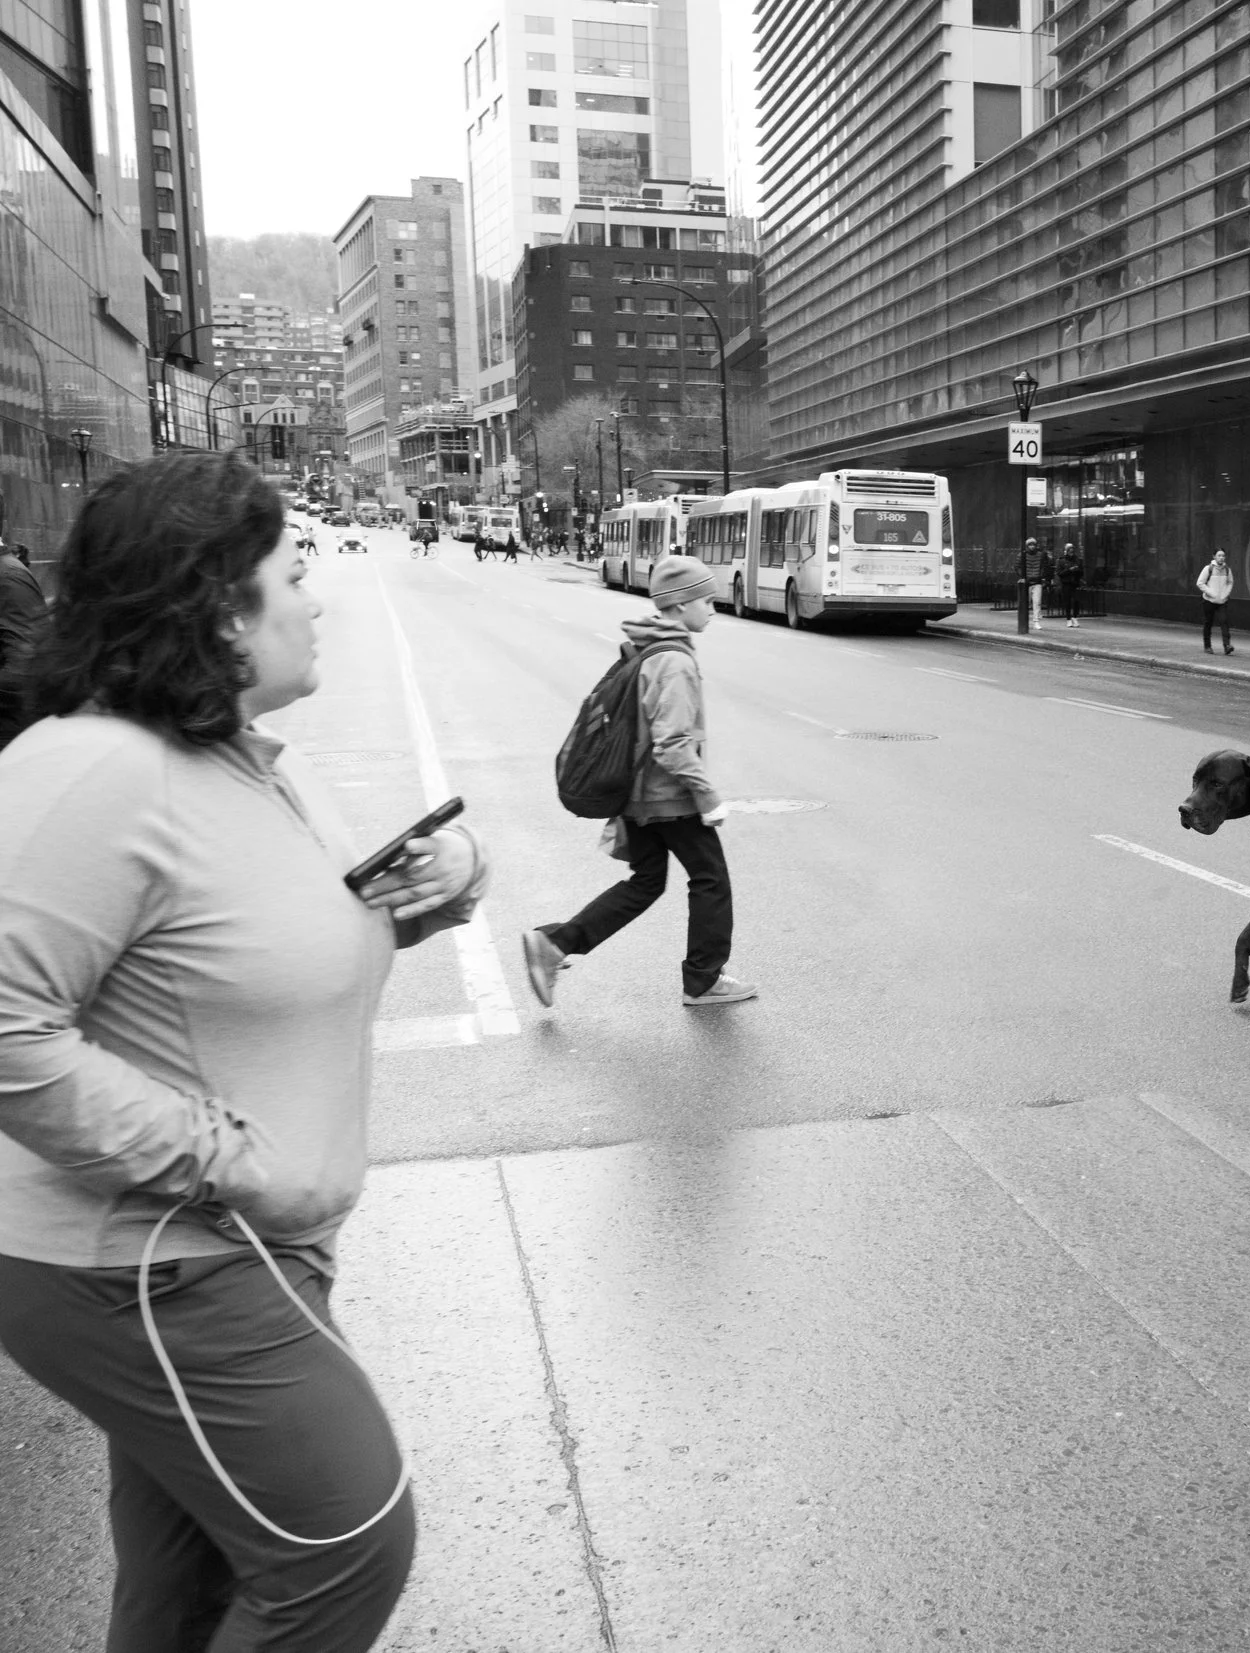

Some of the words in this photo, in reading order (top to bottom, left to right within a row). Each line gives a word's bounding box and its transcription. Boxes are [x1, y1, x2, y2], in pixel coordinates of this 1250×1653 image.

[1012, 440, 1038, 458] 40
[877, 512, 907, 522] 31-805
[883, 532, 898, 543] 165
